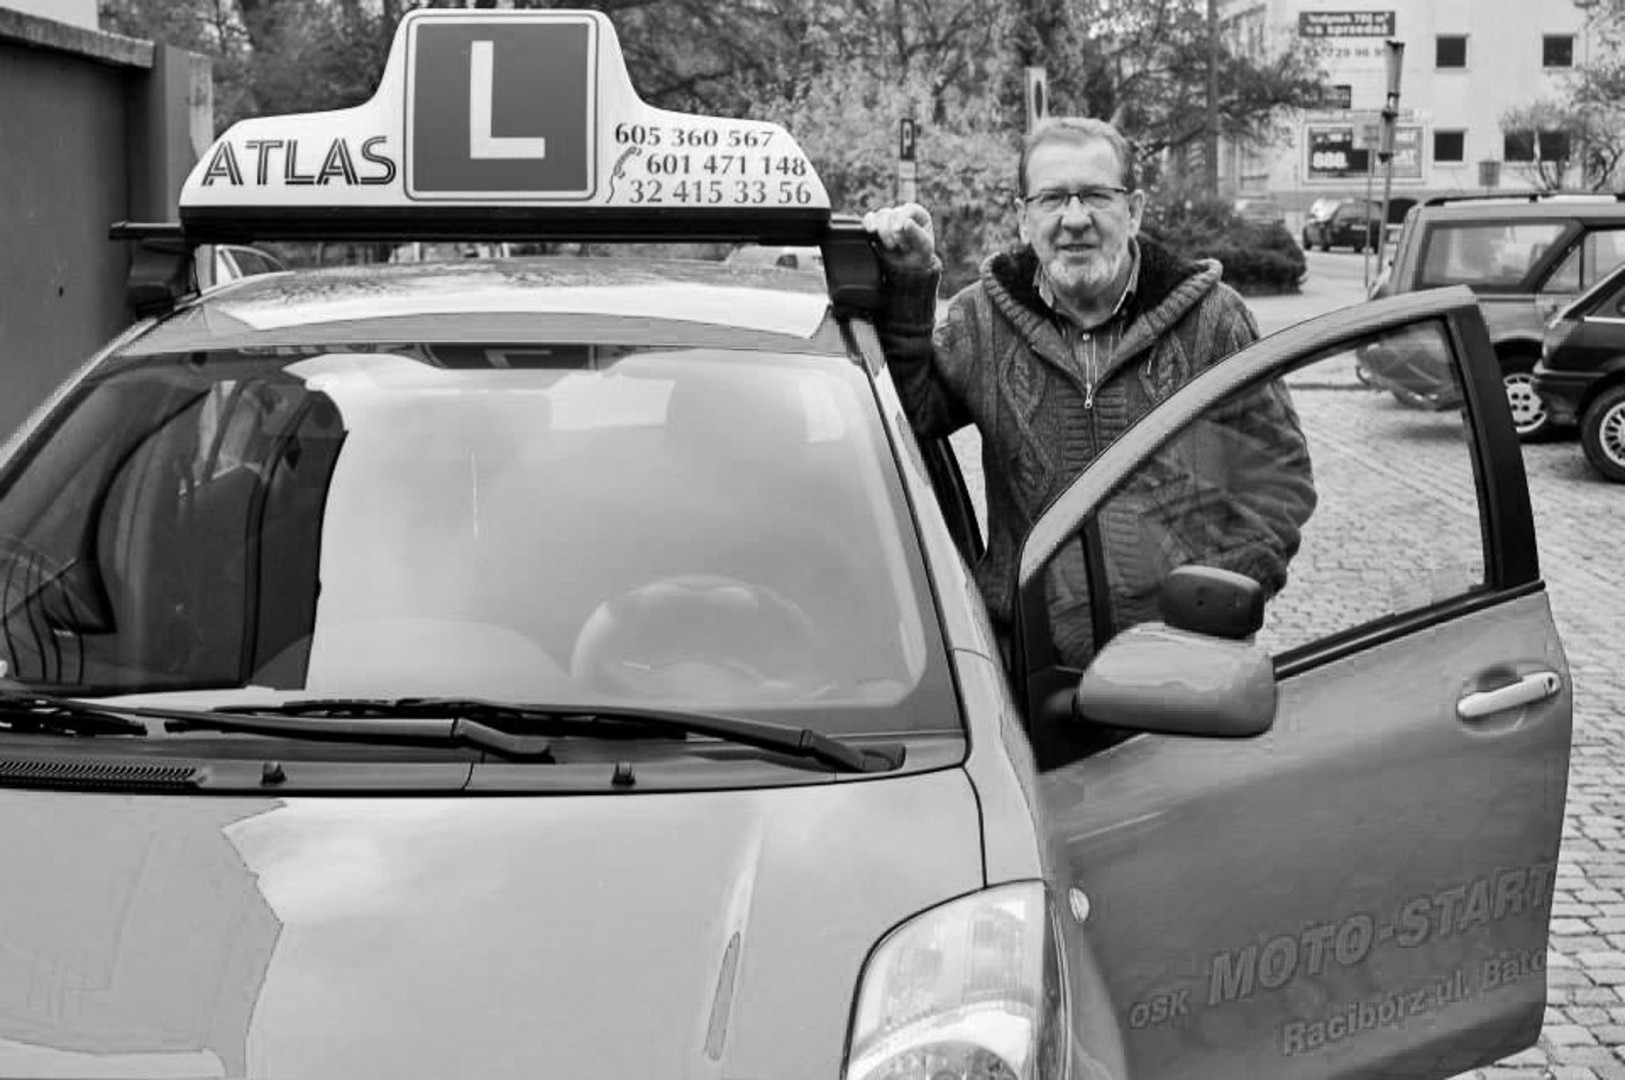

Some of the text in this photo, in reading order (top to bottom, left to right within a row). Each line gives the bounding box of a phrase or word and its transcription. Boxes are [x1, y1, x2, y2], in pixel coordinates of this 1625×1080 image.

[469, 40, 545, 159] L
[614, 123, 774, 148] 605 360 567
[201, 135, 397, 187] ATLAS
[646, 153, 806, 176] 601 471 148
[629, 179, 811, 204] 32 415 33 56
